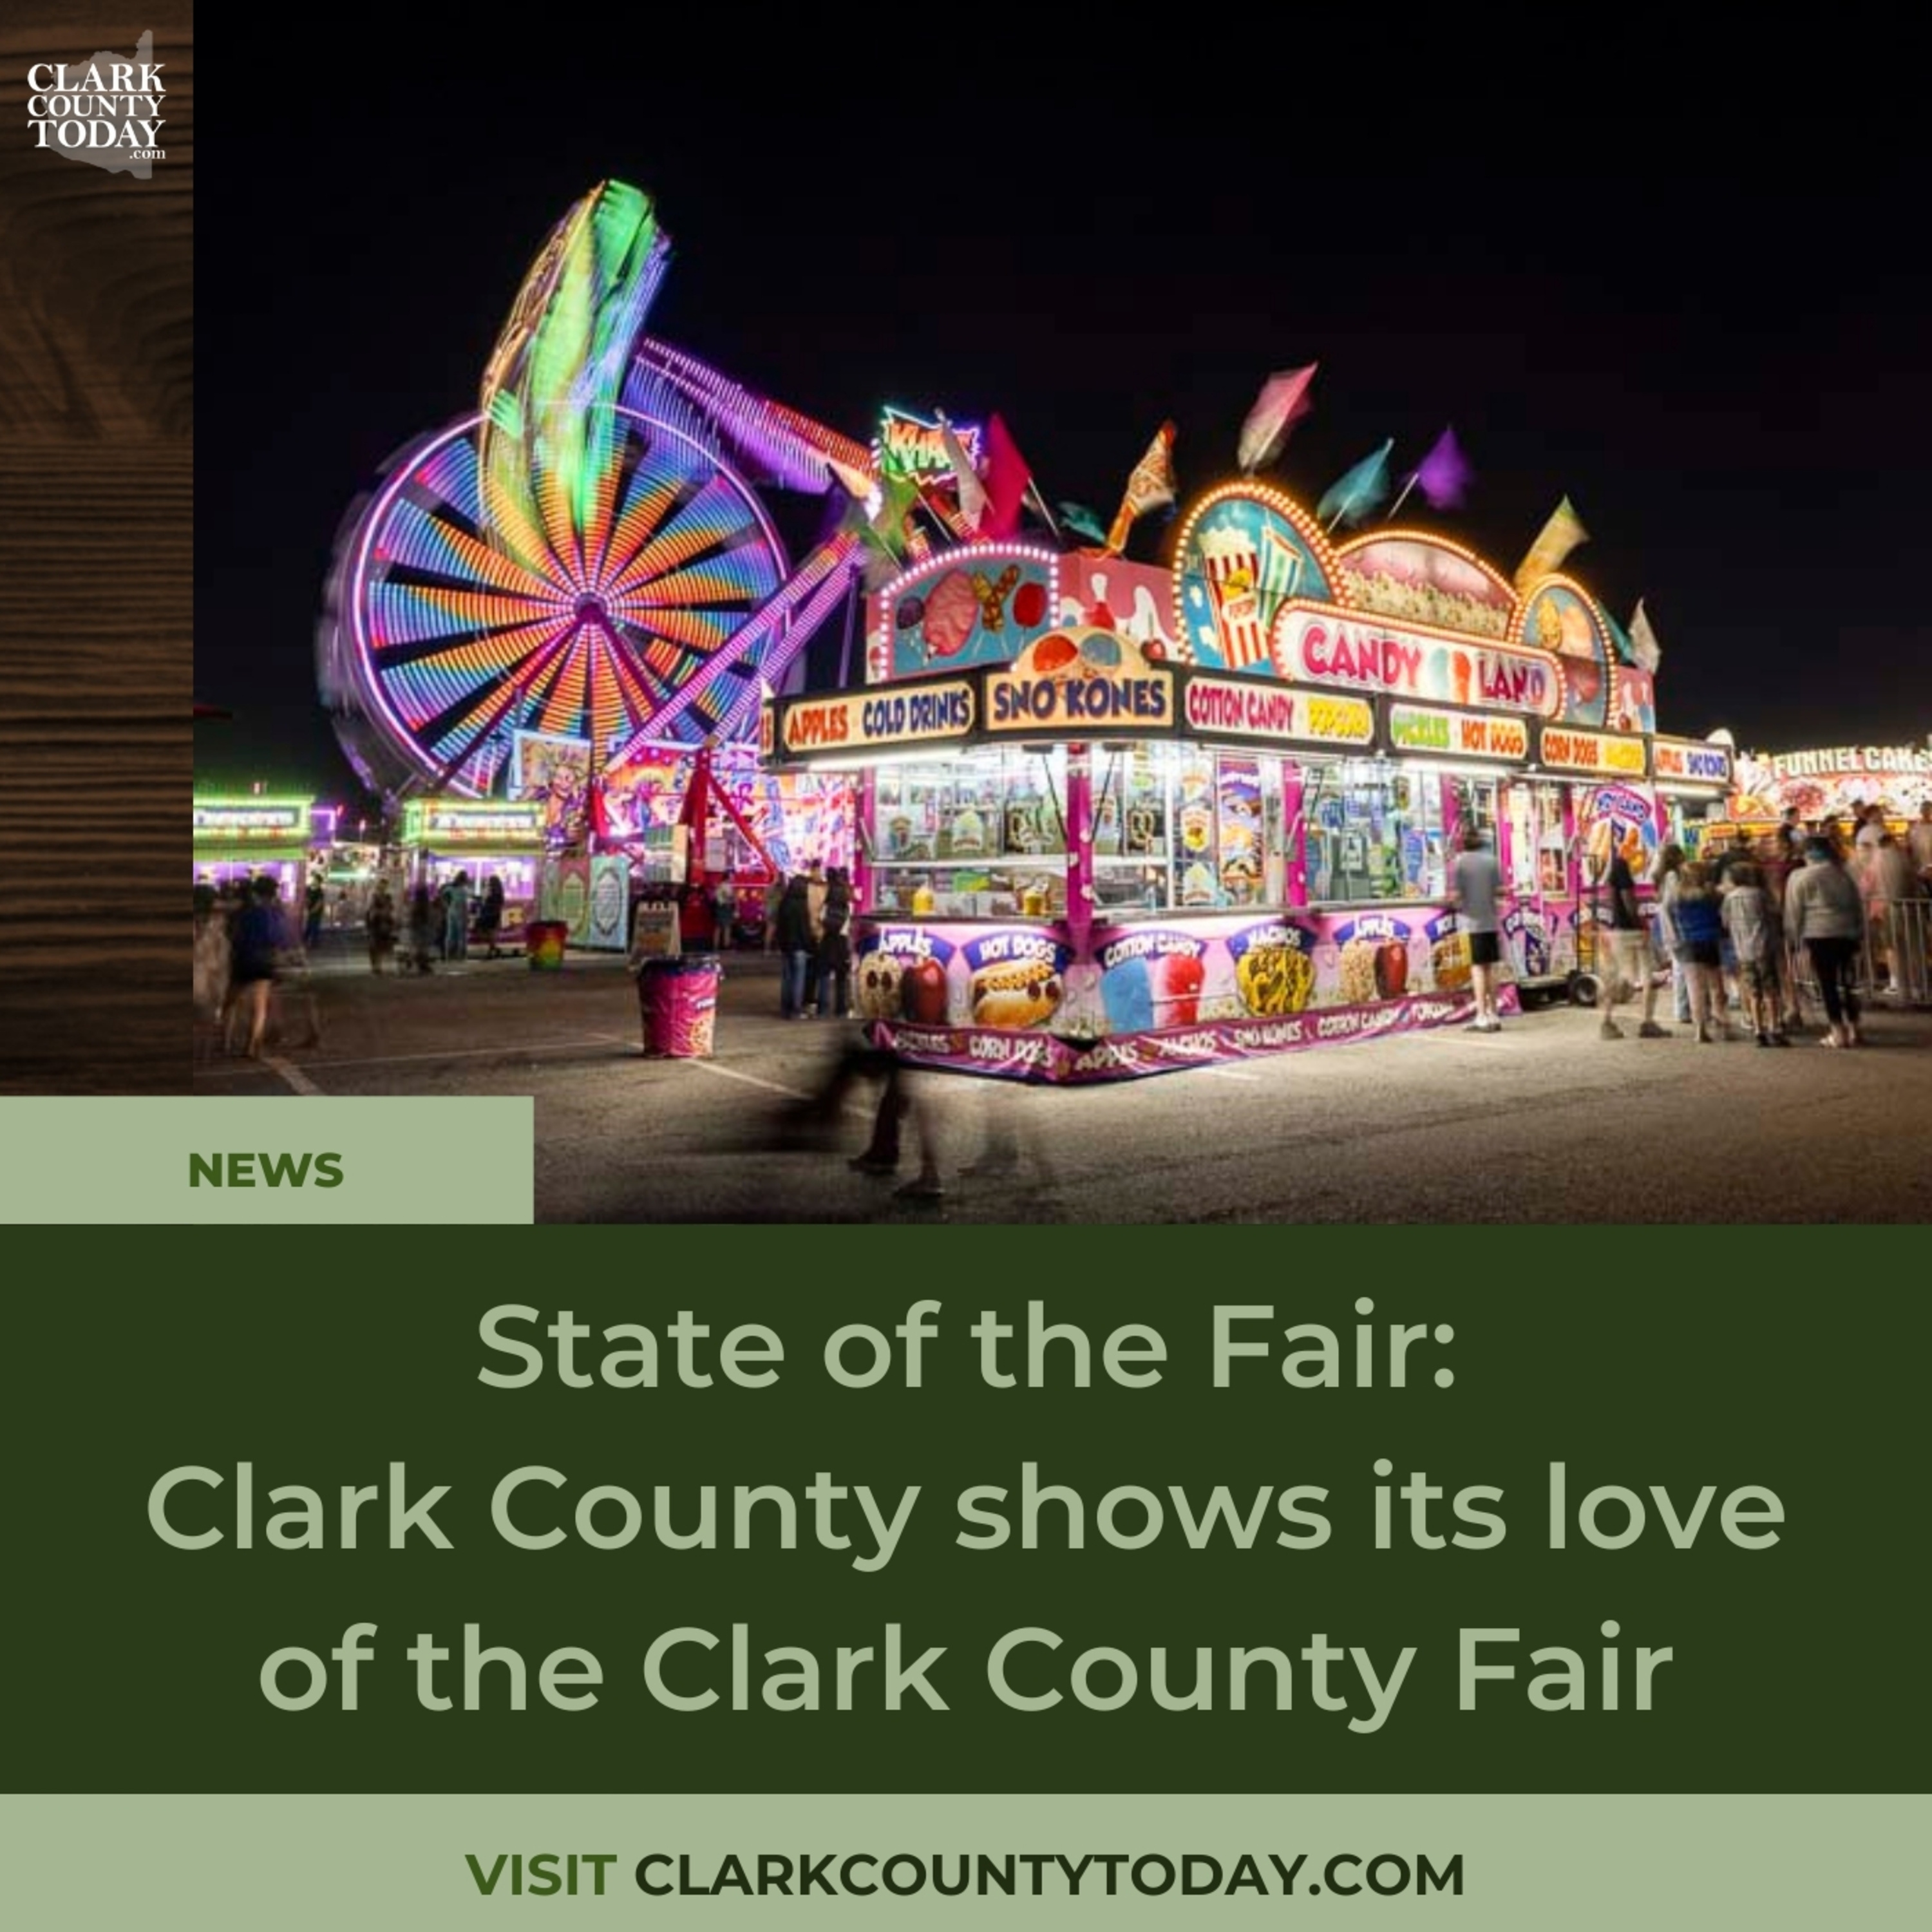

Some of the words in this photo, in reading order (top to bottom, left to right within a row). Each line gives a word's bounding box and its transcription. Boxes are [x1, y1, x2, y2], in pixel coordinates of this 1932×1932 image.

[1302, 626, 1423, 688] CANDY
[1478, 652, 1546, 706] LAND
[788, 705, 849, 746] APPLES
[862, 697, 905, 738] COLD
[909, 688, 971, 730] DRINKS
[993, 681, 1056, 722] SNO
[1065, 678, 1166, 719] KONES
[1190, 684, 1243, 726] COTTON
[1247, 691, 1294, 732] CANDY
[1773, 746, 1863, 778] FUNNEL
[979, 936, 1009, 961] HOT
[1012, 935, 1057, 962] DOGS
